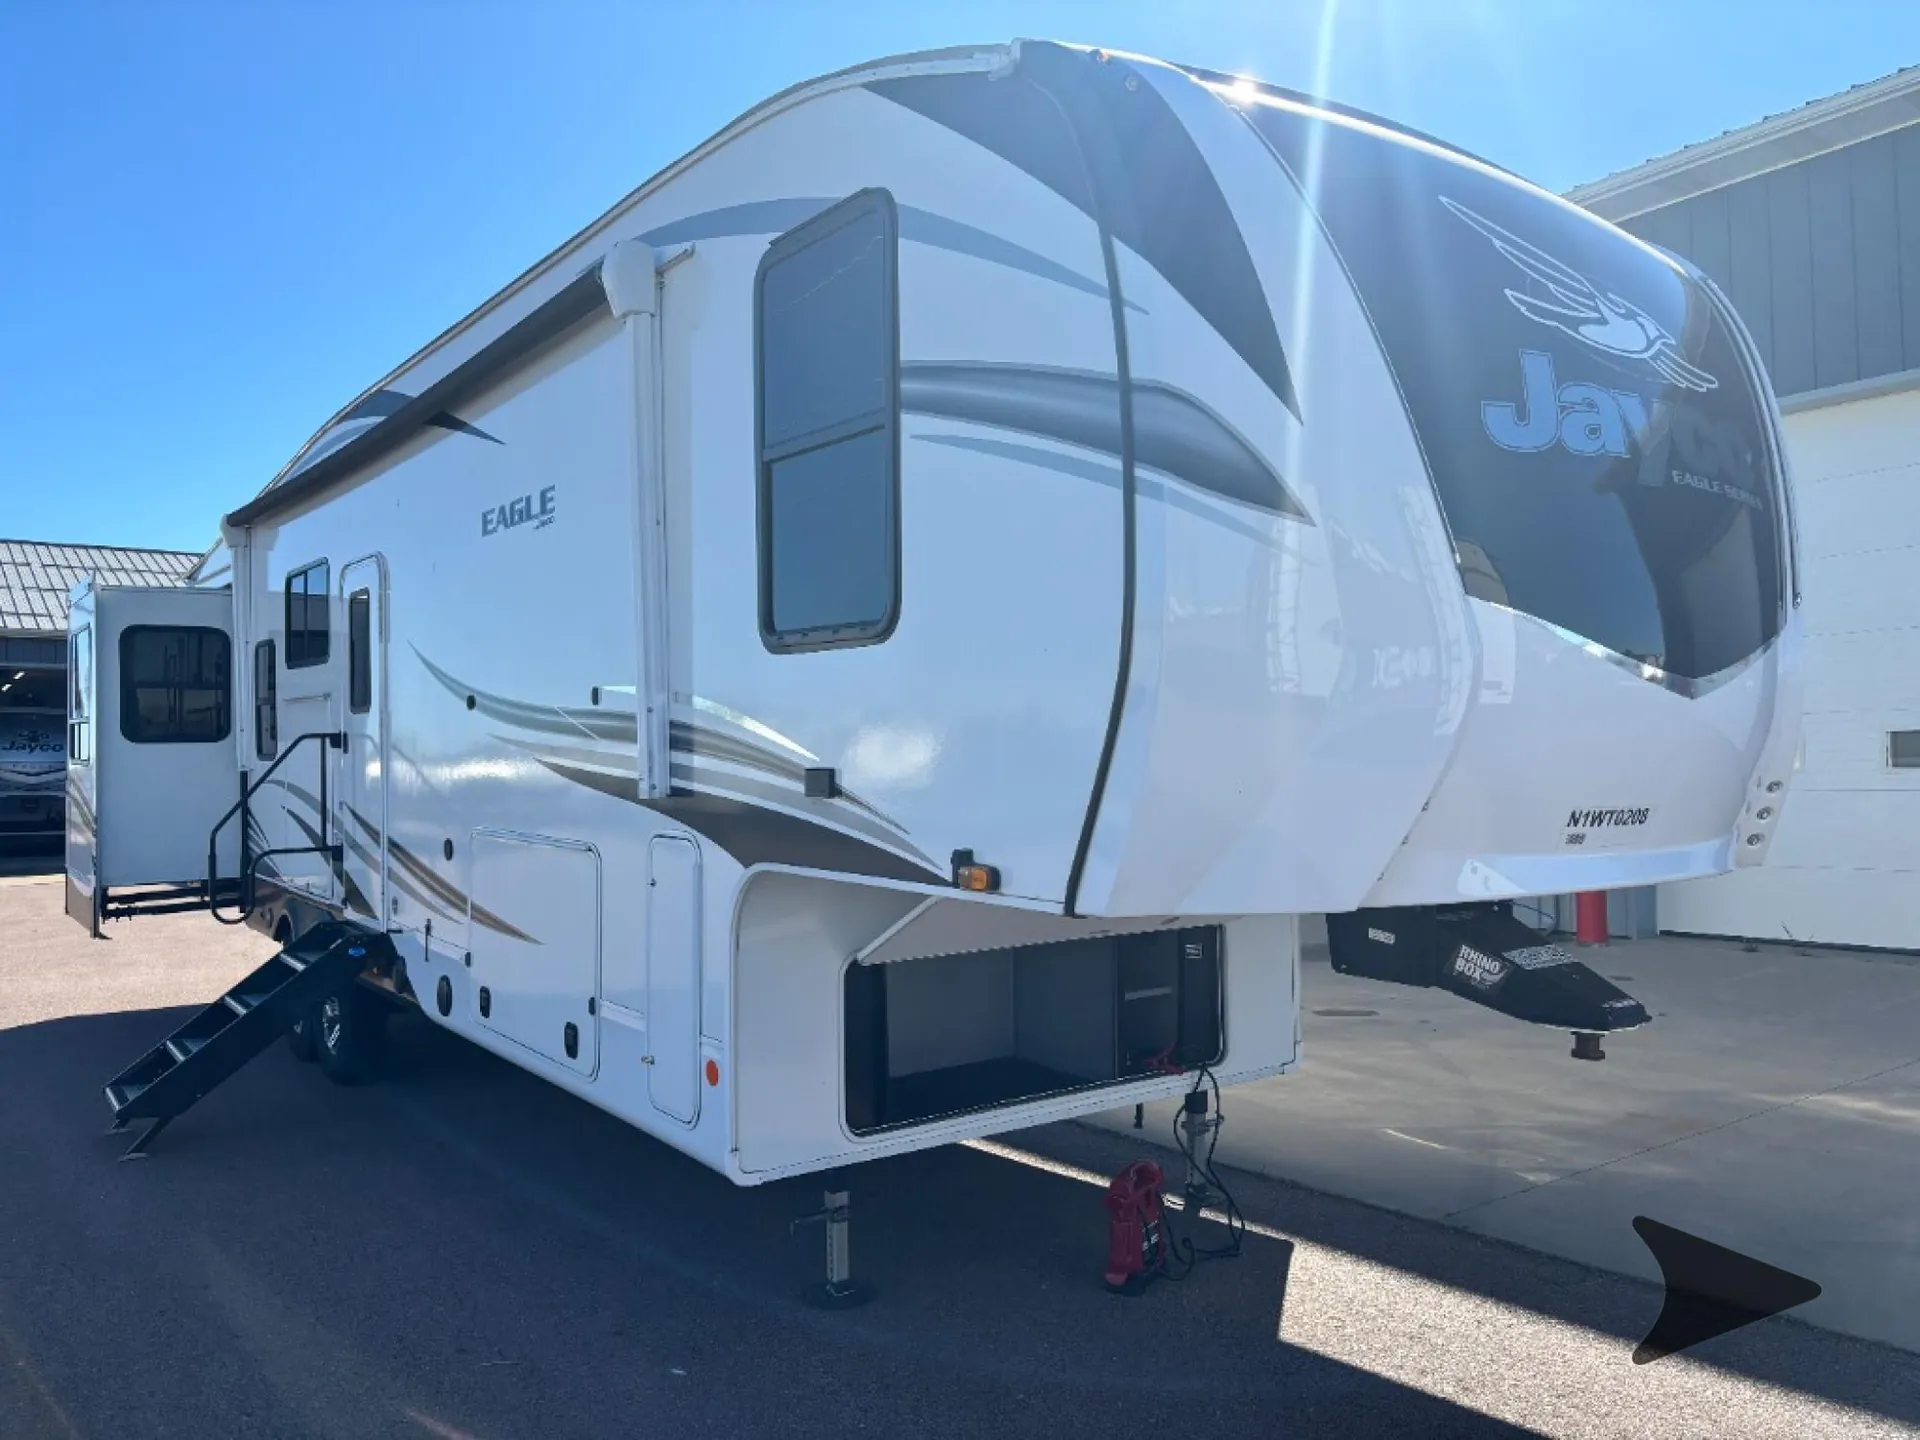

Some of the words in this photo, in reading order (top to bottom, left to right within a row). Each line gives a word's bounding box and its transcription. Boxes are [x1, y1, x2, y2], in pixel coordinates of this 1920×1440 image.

[482, 484, 555, 537] EAGLE
[2, 740, 65, 754] Jayco
[1567, 808, 1650, 827] N1WT0208
[1455, 957, 1484, 981] BOX
[1459, 945, 1500, 974] RHINO
